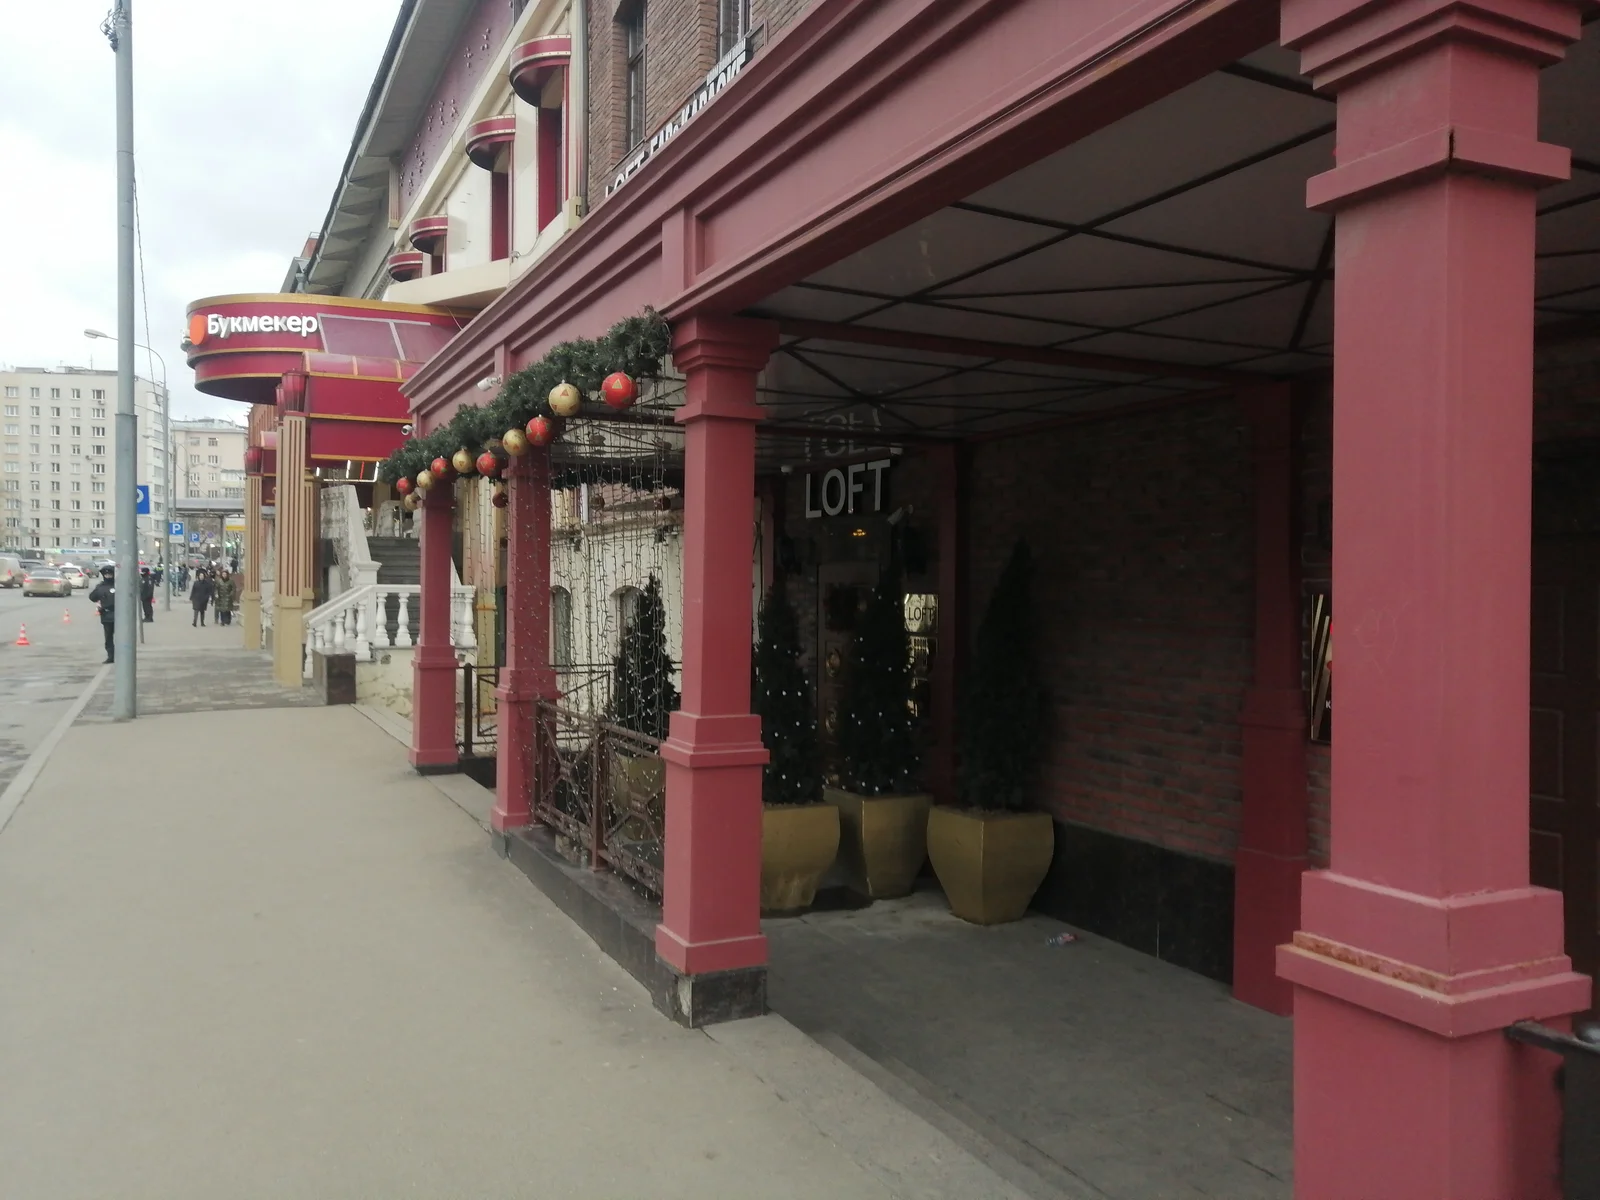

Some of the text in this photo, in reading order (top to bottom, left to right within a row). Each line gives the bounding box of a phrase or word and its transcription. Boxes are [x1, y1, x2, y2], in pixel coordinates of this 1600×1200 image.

[207, 313, 318, 338] Букмекер
[805, 458, 891, 519] LOFT
[908, 606, 934, 622] LOFT
